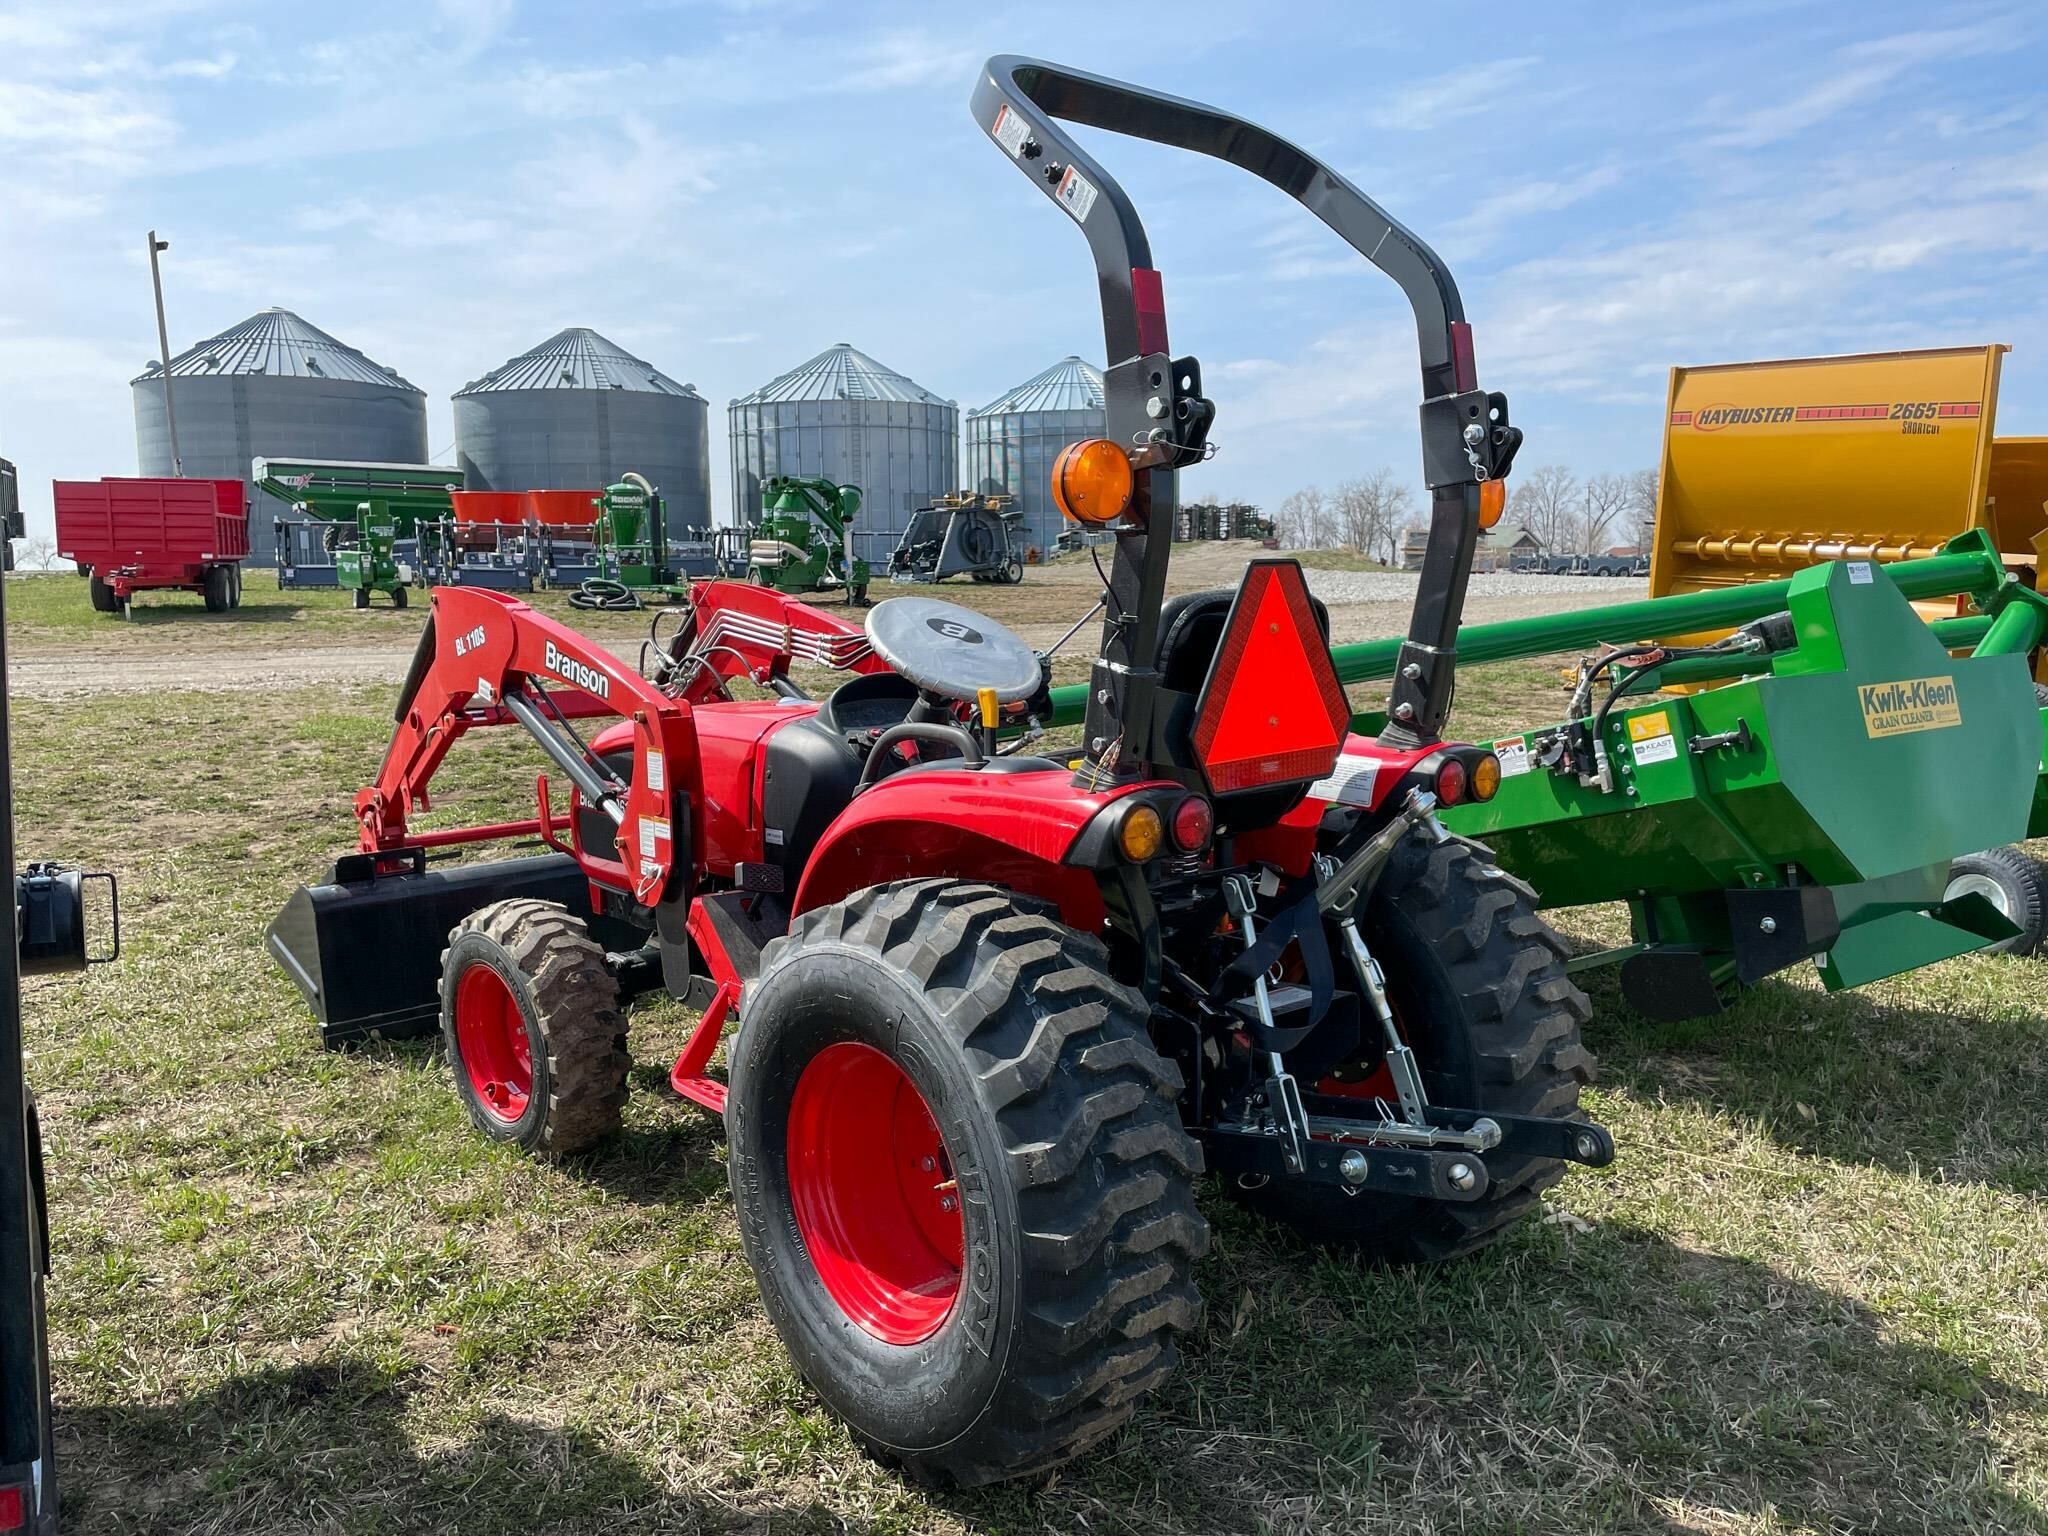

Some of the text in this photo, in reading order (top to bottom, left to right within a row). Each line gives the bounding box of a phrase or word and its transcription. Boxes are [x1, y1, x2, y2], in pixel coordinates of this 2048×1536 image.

[1698, 407, 1795, 425] HAYBUSTER
[1889, 402, 1939, 420] 2665
[455, 624, 486, 657] BL 110S
[545, 640, 609, 699] Branson
[1863, 681, 1955, 715] Kwik-Kleen
[1873, 715, 1900, 729] GRAIN
[1901, 711, 1934, 725] CLEANER
[1645, 740, 1672, 750] KEAST
